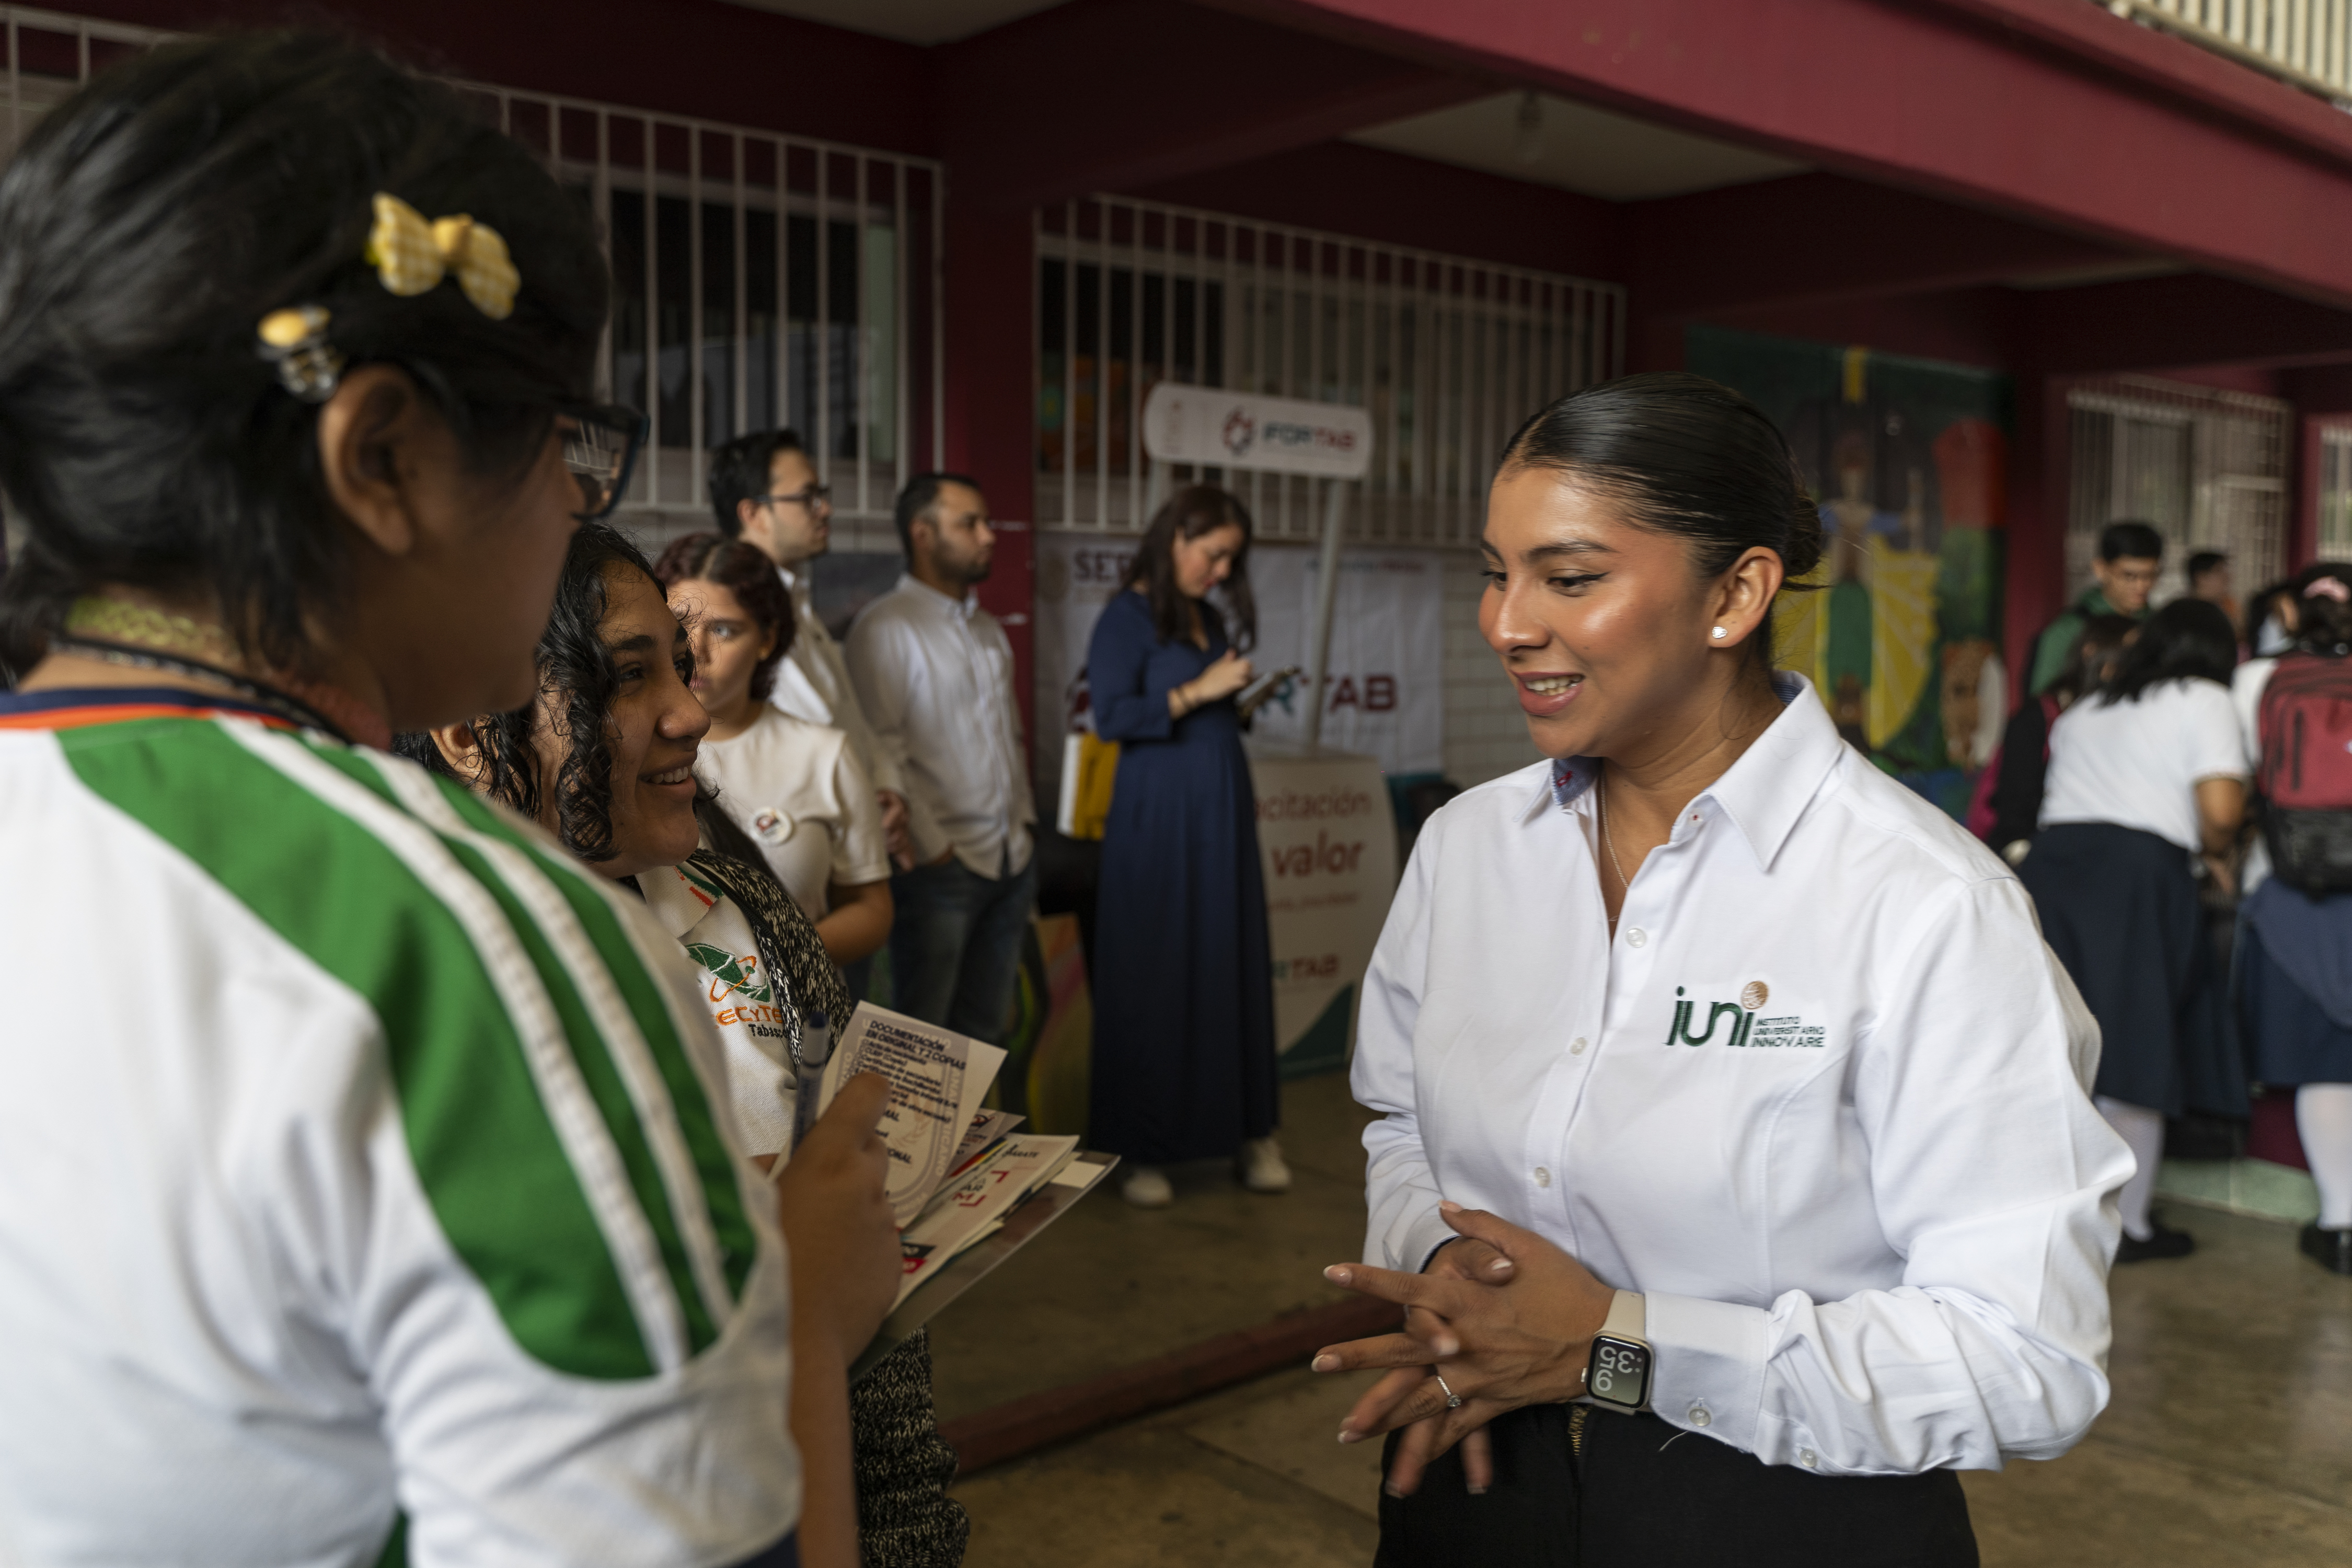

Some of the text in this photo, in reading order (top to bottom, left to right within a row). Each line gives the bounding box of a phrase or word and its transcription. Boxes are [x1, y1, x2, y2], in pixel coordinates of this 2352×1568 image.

[1271, 830, 1363, 878] valor
[712, 1005, 783, 1028] ECYTE
[866, 1029, 878, 1039] EN
[878, 1033, 917, 1052] ORIGINAL
[926, 1050, 933, 1058] 2
[931, 1052, 966, 1070] COPIAS
[870, 1021, 944, 1052] DOCUMENTACIÓN
[1751, 1036, 1826, 1047] INNOVARE
